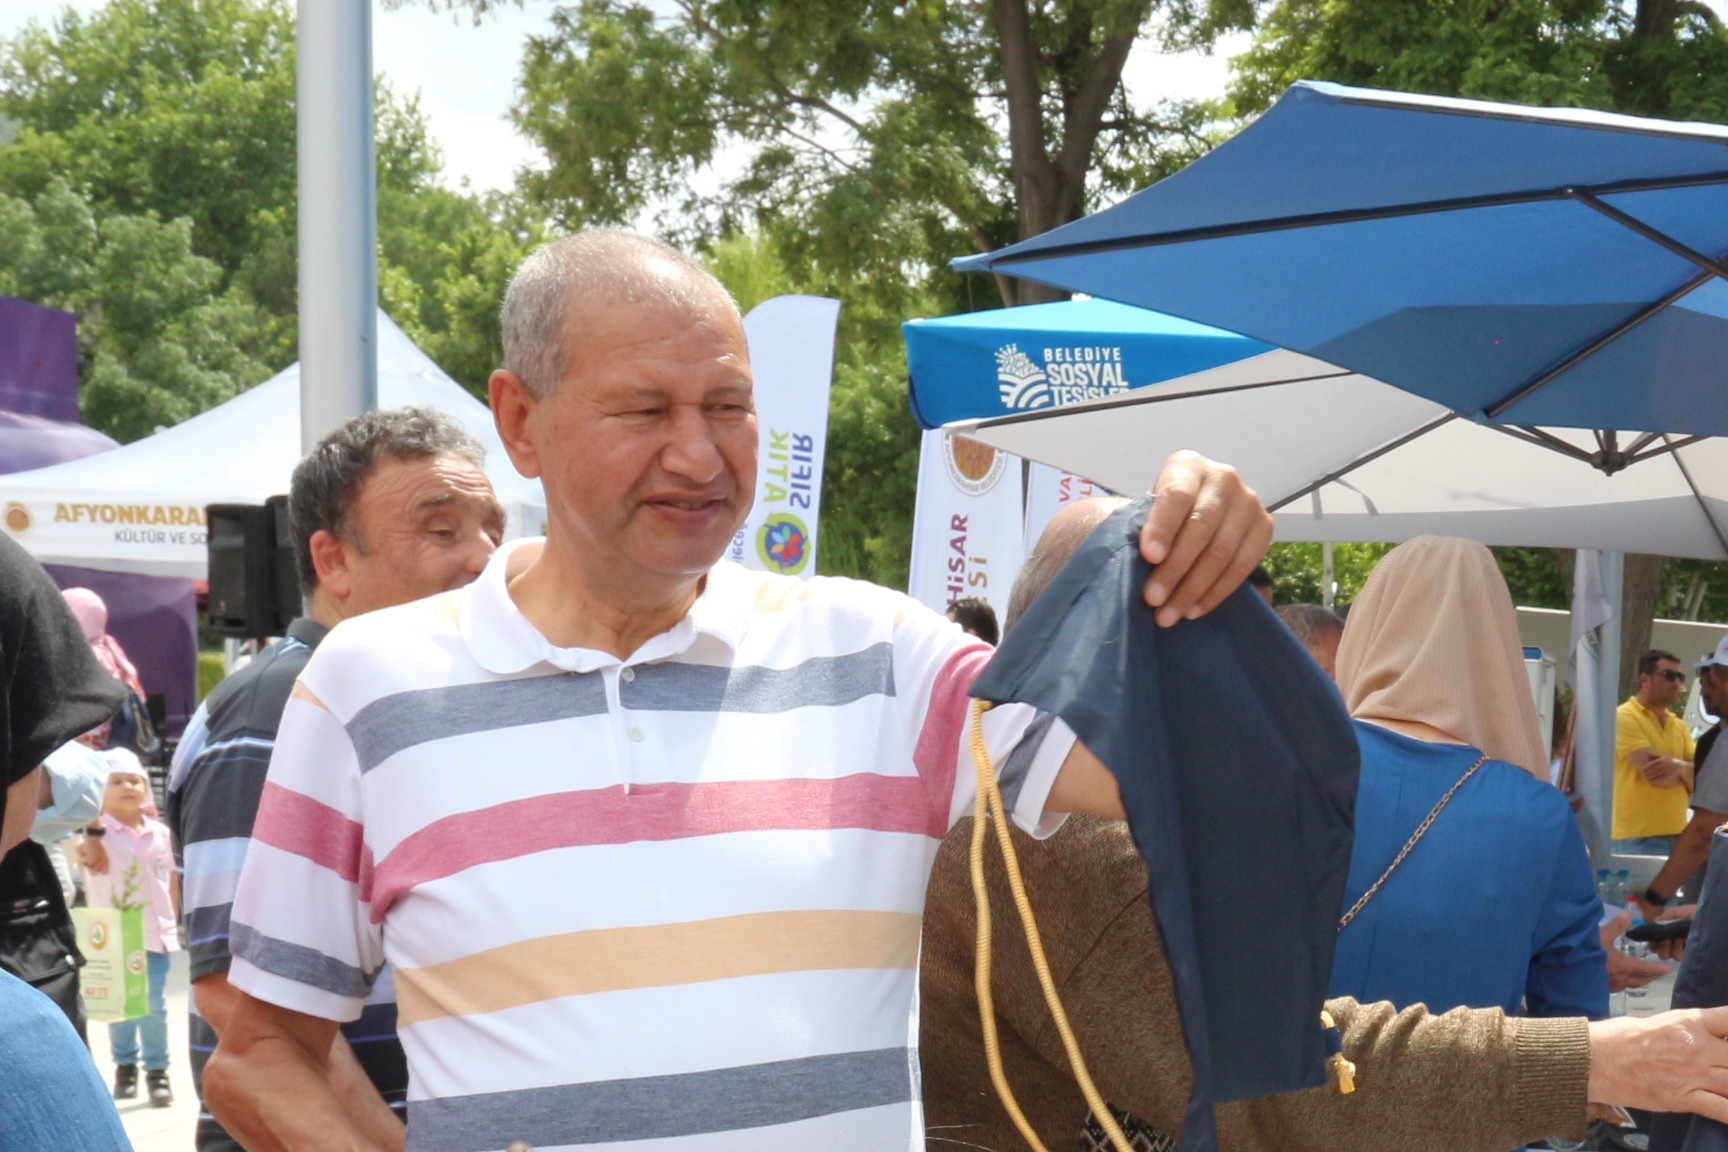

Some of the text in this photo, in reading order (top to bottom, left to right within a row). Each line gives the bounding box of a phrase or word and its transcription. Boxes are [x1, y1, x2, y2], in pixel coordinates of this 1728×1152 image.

[1043, 346, 1121, 362] BELEDİYE
[1046, 363, 1129, 387] SOSYAL
[115, 530, 166, 544] KÜLTÜR
[169, 532, 187, 544] VE
